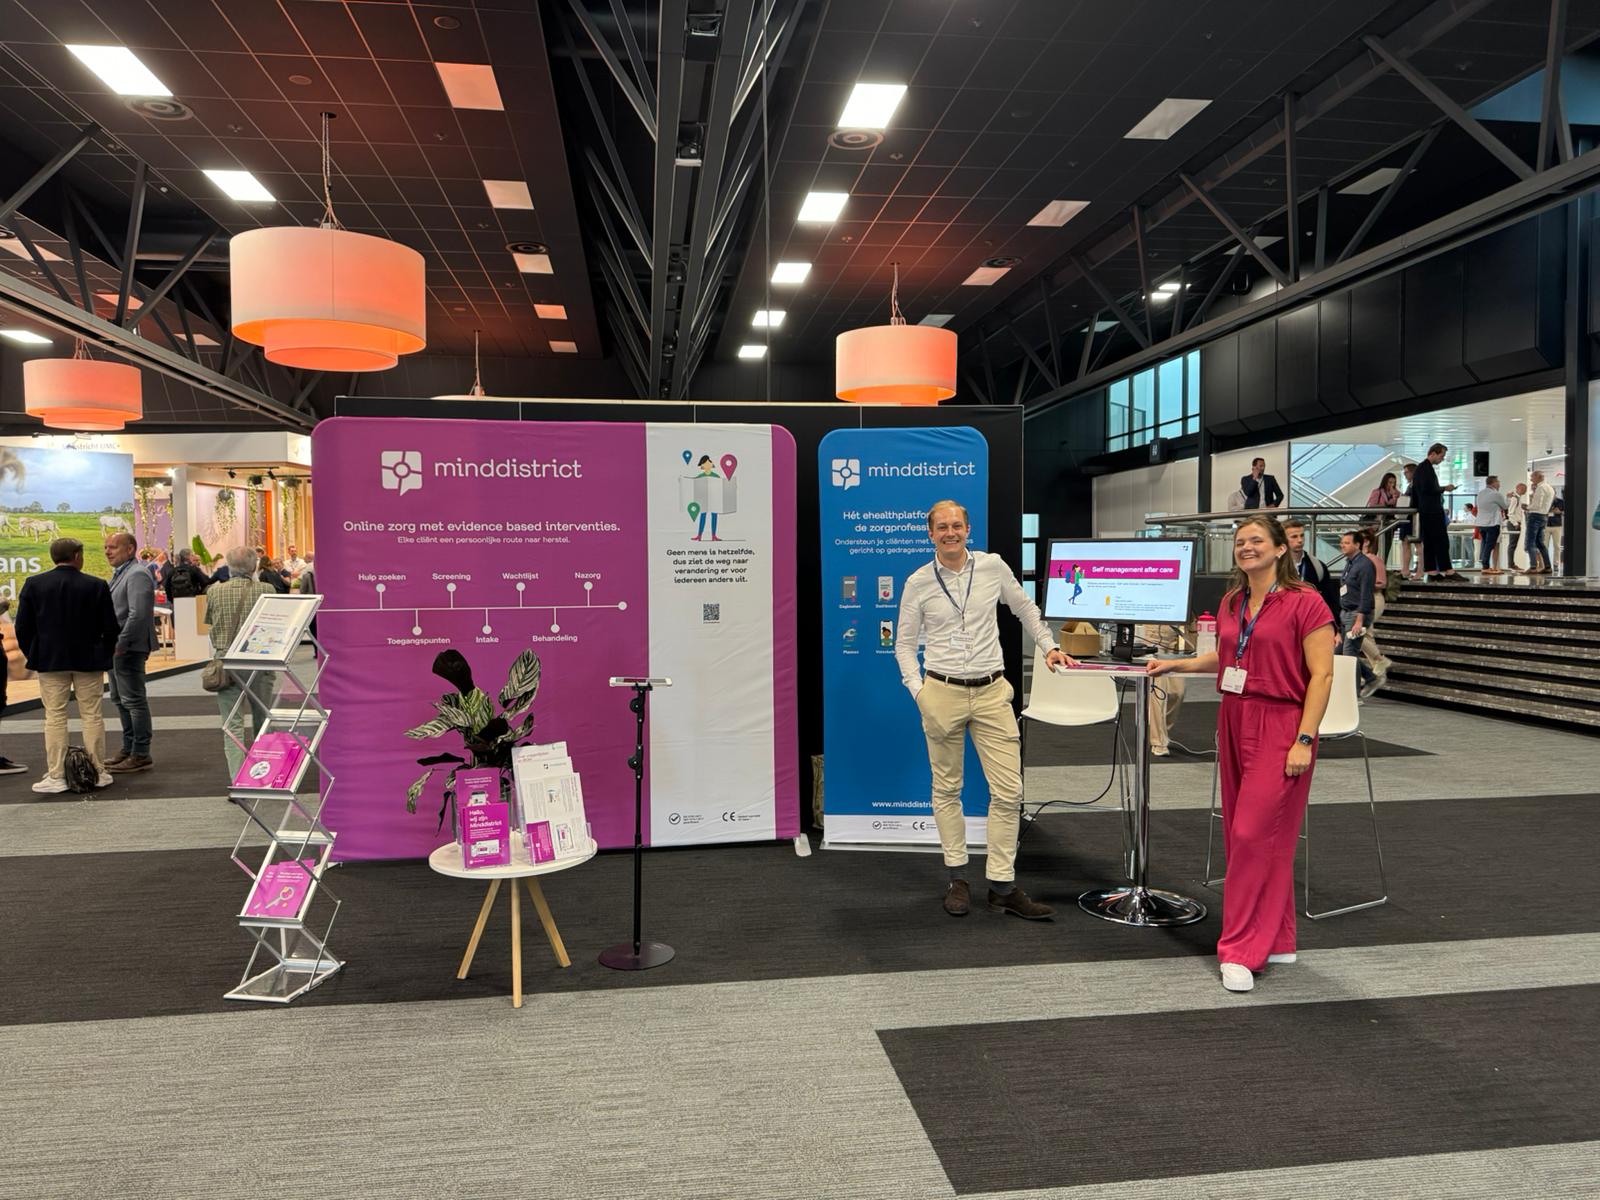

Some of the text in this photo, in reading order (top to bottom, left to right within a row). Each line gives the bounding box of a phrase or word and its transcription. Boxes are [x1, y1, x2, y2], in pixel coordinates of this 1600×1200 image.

[434, 457, 583, 478] minddistrict
[868, 461, 976, 477] minddistrict
[843, 510, 930, 521] Hét ehealthplatfor
[343, 520, 621, 533] Online zorg met evidence based interventies.
[855, 523, 930, 533] de zorgprofessi
[455, 536, 501, 545] persoonlijke
[834, 538, 876, 546] Ondersteun
[876, 538, 884, 546] je
[849, 546, 874, 554] gericht
[1104, 566, 1143, 574] management
[358, 573, 377, 581] Hulp
[432, 573, 471, 581] Screening
[502, 572, 539, 580] Wachtlijst
[574, 572, 601, 580] Nazorg
[387, 637, 451, 645] Toegangspunten
